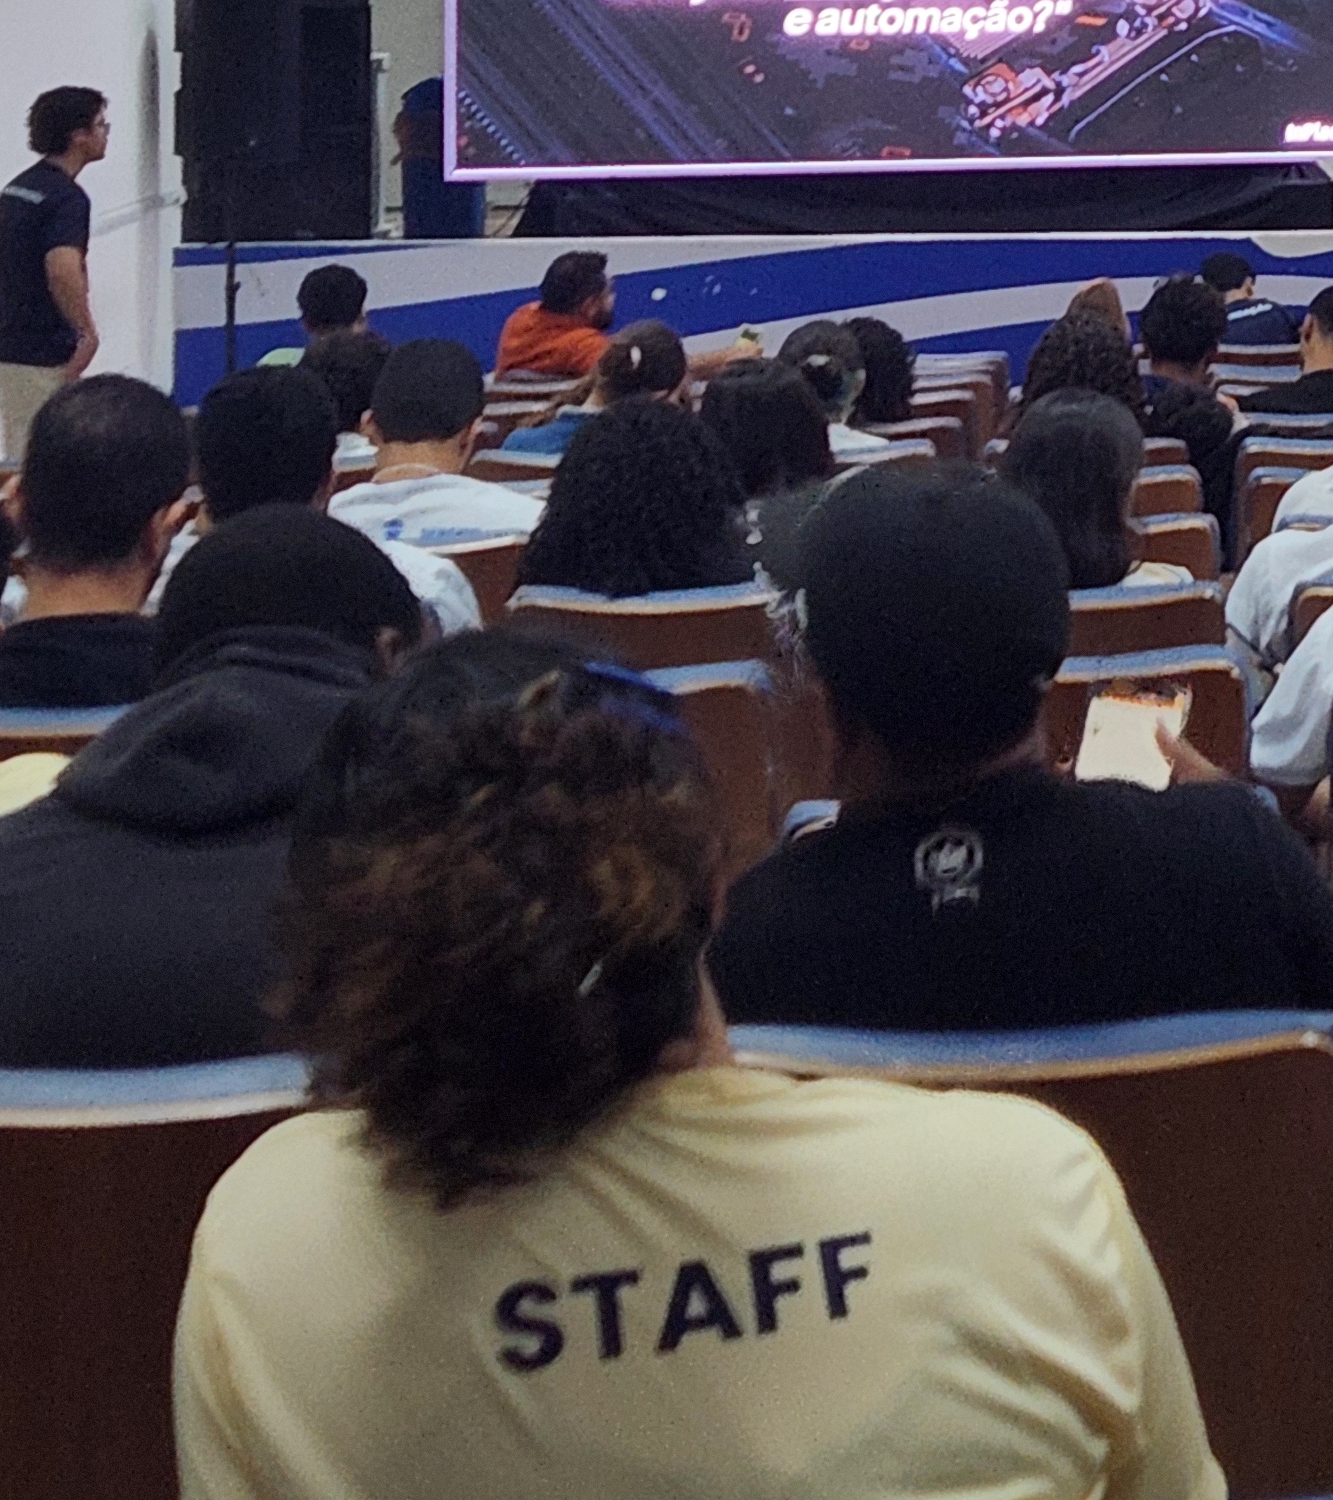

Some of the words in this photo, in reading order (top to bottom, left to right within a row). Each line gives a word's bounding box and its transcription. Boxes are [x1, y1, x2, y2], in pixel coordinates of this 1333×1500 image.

[783, 8, 813, 36] e
[814, 0, 1074, 40] automação?"
[494, 1231, 871, 1375] STAFF
